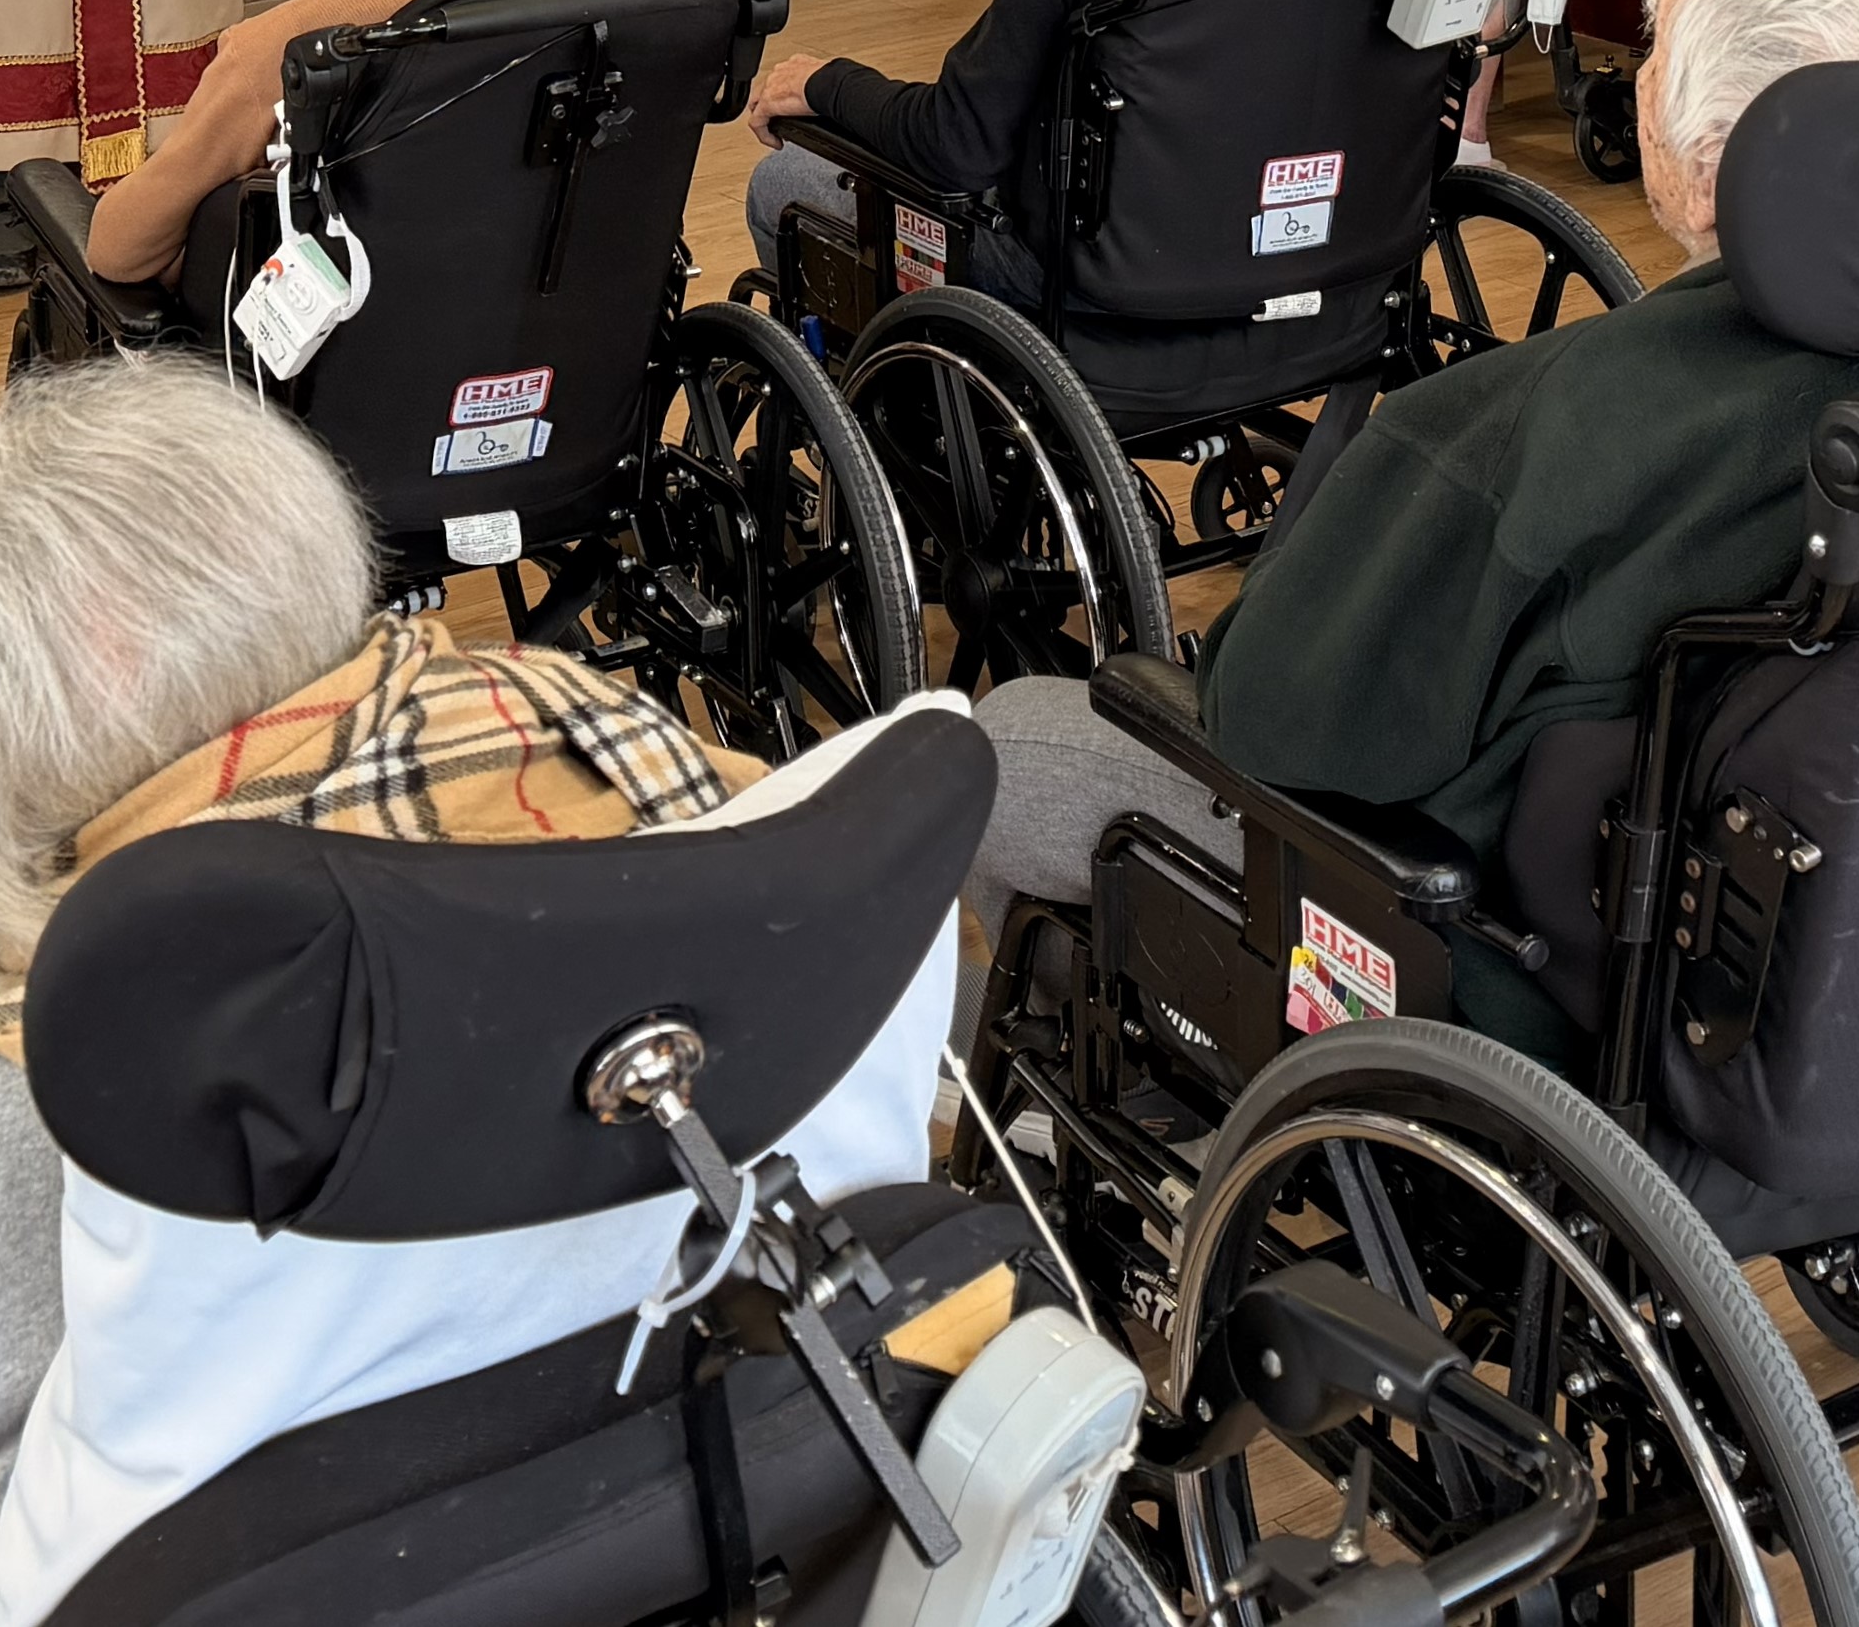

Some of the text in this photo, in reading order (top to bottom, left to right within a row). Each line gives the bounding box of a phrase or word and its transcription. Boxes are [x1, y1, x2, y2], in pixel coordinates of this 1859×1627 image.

[1272, 160, 1335, 183] HME
[898, 209, 943, 245] HME
[465, 376, 542, 402] HME
[1306, 908, 1390, 989] HME
